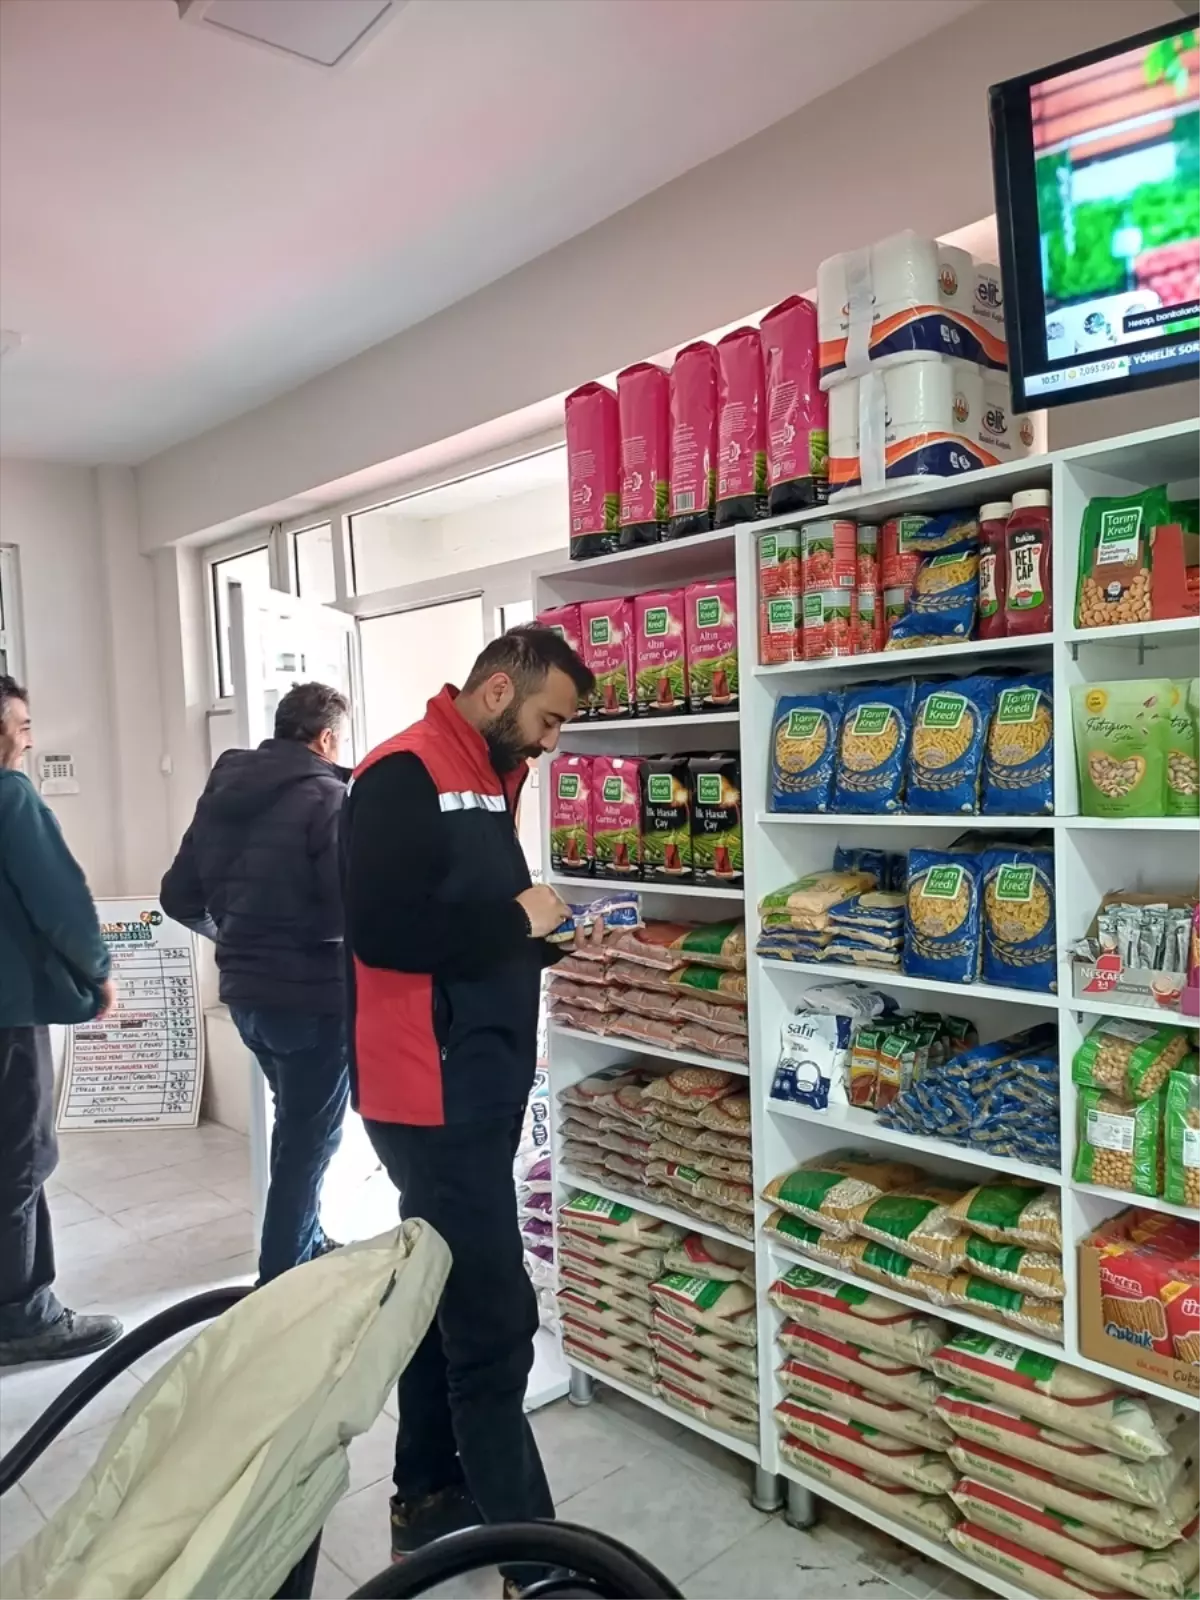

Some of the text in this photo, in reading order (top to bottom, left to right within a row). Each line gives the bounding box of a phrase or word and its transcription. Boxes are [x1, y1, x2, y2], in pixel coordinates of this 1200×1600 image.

[977, 281, 1002, 304] elit
[1133, 346, 1177, 365] YÖNELİK
[985, 408, 1007, 432] elit
[1106, 514, 1138, 526] Tarım
[1107, 523, 1134, 537] Kredi
[1015, 547, 1032, 566] KET
[1016, 564, 1034, 582] CAP
[700, 631, 718, 641] Altın
[931, 699, 962, 711] Tarım
[1004, 702, 1030, 714] Kredi
[929, 710, 957, 720] Kredi
[656, 807, 677, 817] Hasat
[705, 808, 727, 819] Hasat
[655, 818, 668, 828] Çay
[704, 820, 718, 831] Çay
